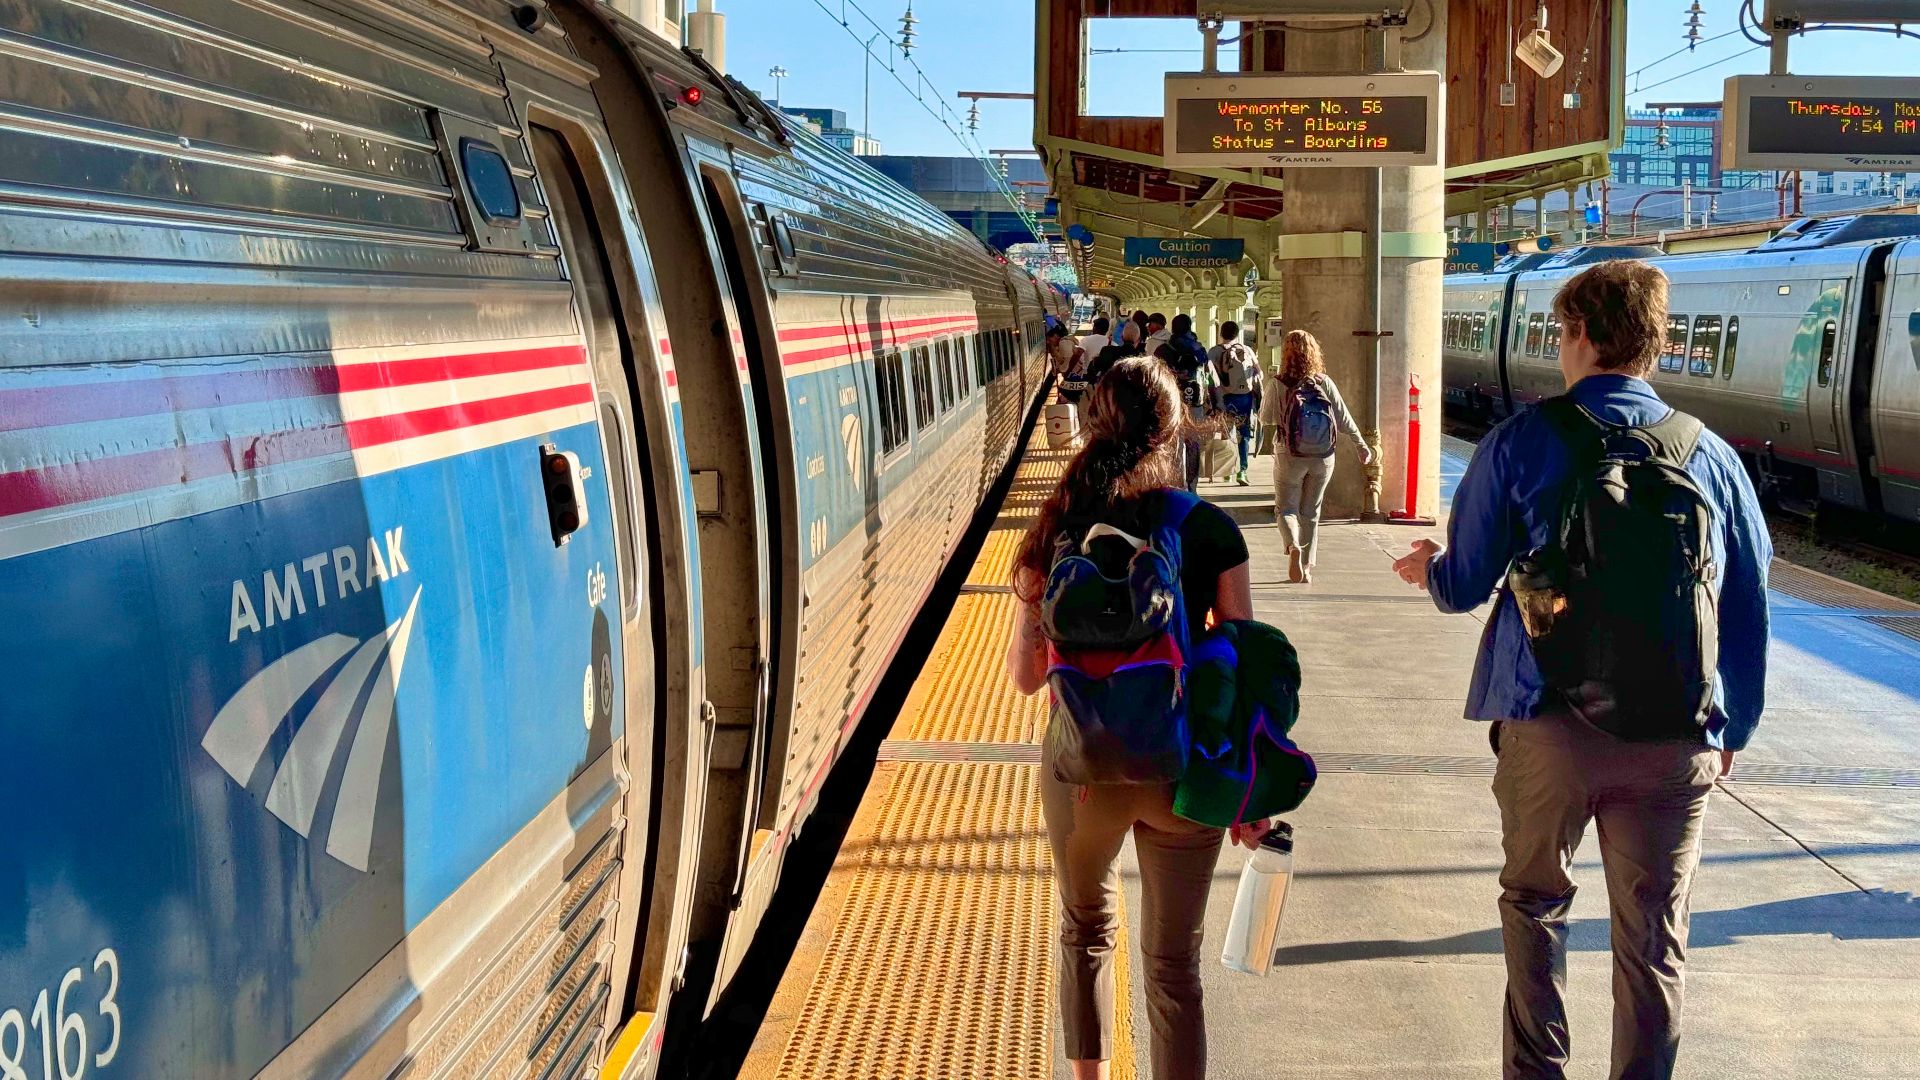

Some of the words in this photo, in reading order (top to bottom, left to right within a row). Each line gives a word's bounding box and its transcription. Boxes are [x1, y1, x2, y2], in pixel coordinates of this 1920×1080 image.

[1218, 101, 1310, 115] Vermonter
[1321, 101, 1349, 114] No.
[1362, 101, 1383, 114] 56
[1787, 101, 1880, 116] Thursday,
[1233, 118, 1254, 131] To
[1264, 118, 1292, 131] St.
[1305, 118, 1368, 131] Albans
[1840, 119, 1883, 133] 7:54
[1895, 119, 1915, 133] AM
[1212, 135, 1274, 148] Status
[1304, 135, 1388, 149] Boarding
[1159, 240, 1211, 252] Caution
[1139, 254, 1167, 266] Low
[1169, 255, 1228, 267] Clearance
[1444, 262, 1479, 271] rance
[228, 526, 410, 643] AMTRAK
[587, 561, 607, 608] Cafe
[0, 947, 121, 1080] 8163
